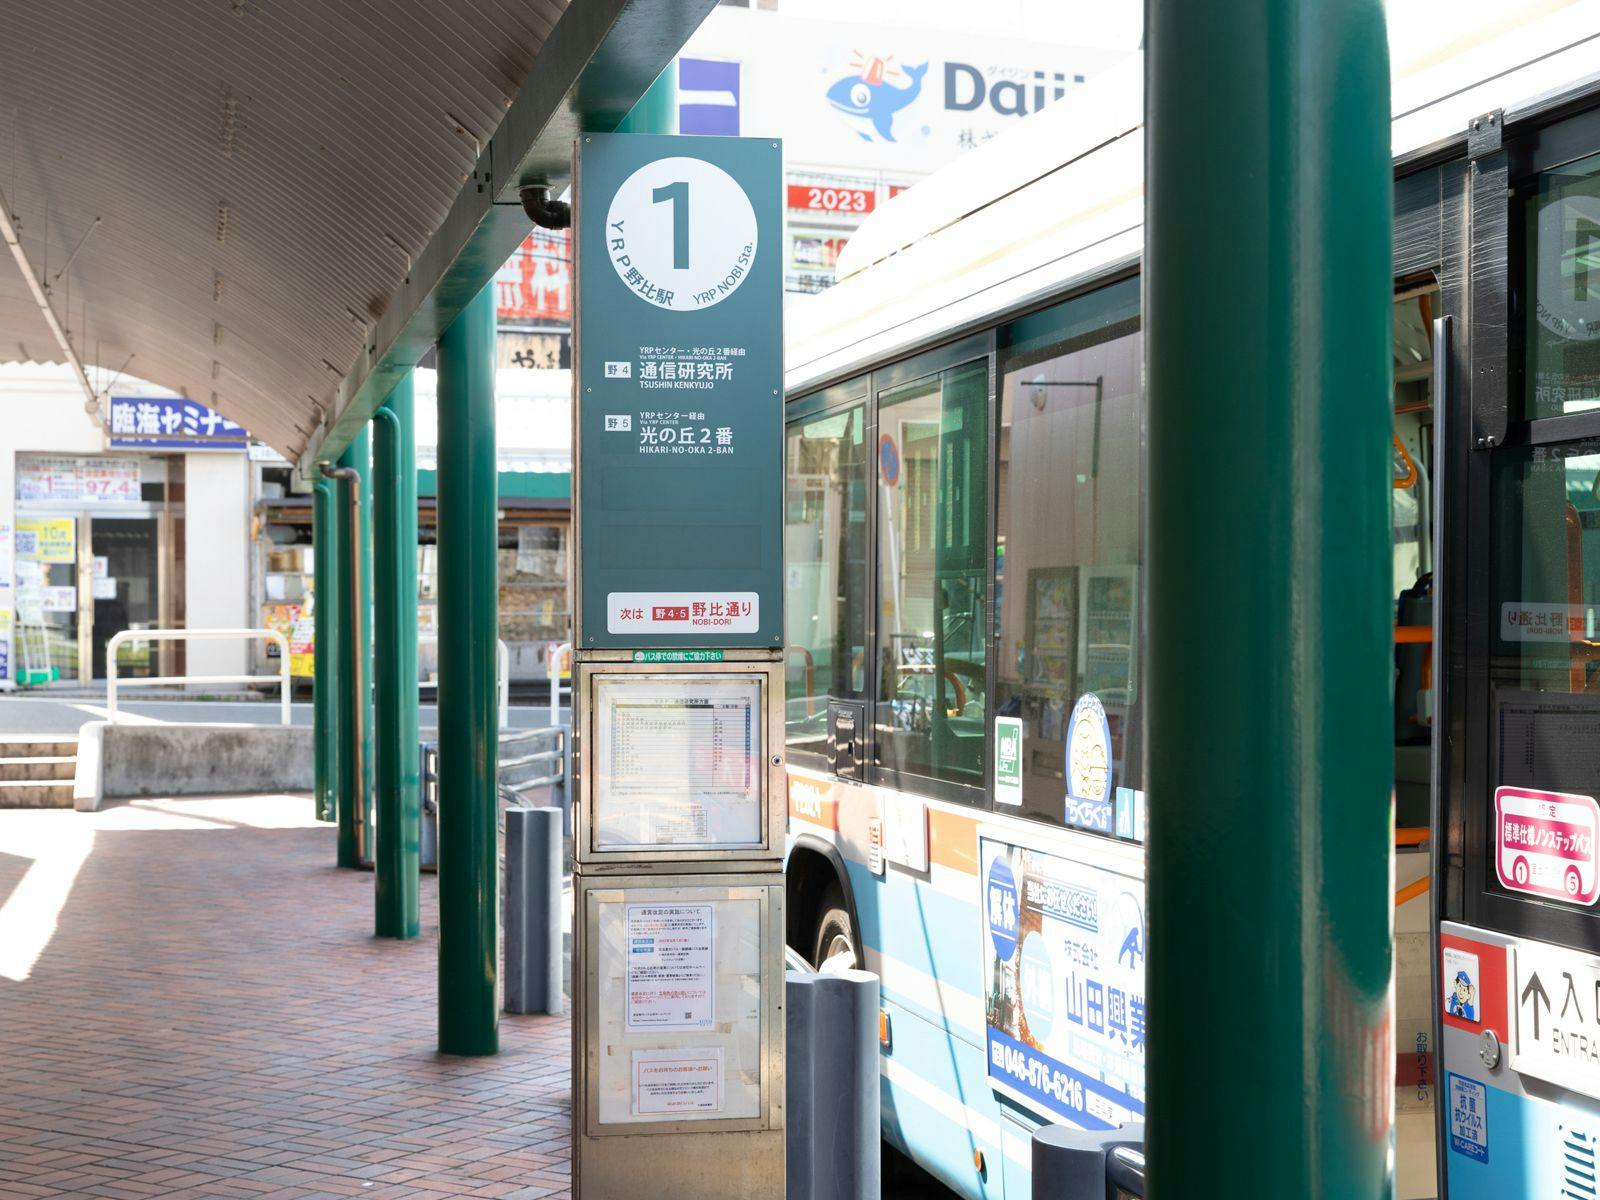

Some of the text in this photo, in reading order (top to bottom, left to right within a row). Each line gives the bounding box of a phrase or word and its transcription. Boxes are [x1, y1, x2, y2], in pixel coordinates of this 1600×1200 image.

[808, 188, 867, 212] 2023
[652, 181, 690, 270] 1
[611, 219, 675, 306] YRP野比駅
[692, 242, 754, 305] YRP NOBI Sta.
[639, 361, 734, 380] 通信研究所
[639, 381, 714, 390] TSUSHIN KENKYUJO
[639, 411, 705, 421] YRPセンター経由
[639, 446, 734, 454] HIKARI-NO-OKA 2-BAN
[620, 607, 644, 620] 次は
[692, 601, 752, 617] 野比通り
[692, 618, 732, 626] NOBI-DORI
[1504, 820, 1592, 856] 標準仕様ノンステップバス
